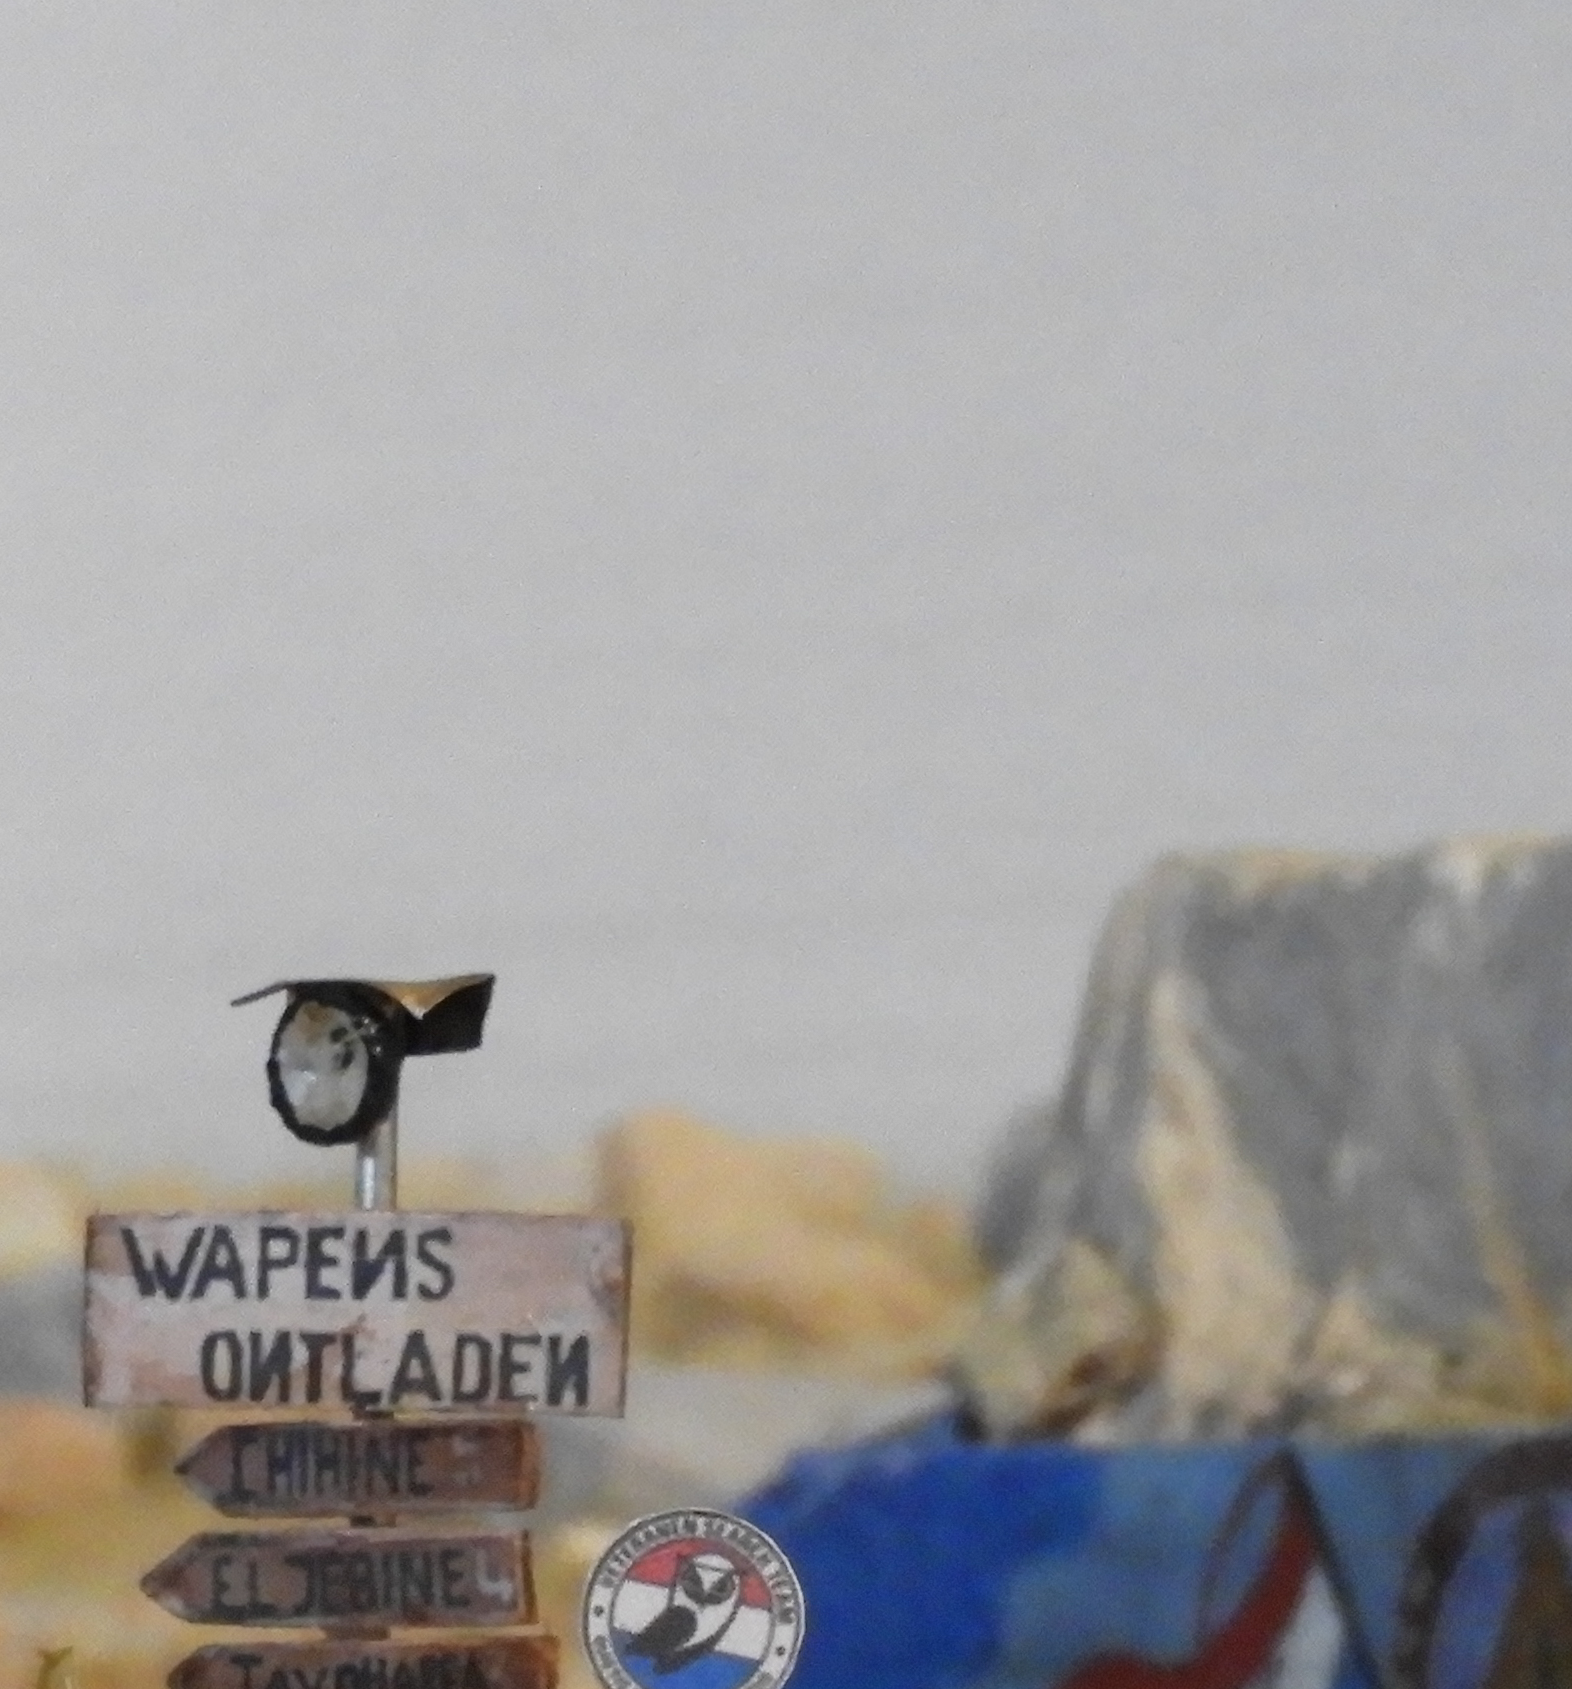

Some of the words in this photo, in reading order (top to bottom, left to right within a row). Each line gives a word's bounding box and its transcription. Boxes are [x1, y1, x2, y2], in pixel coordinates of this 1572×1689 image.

[121, 1225, 456, 1302] WAPENS
[199, 1329, 591, 1410] ONTLADEN
[210, 1554, 279, 1618] EL
